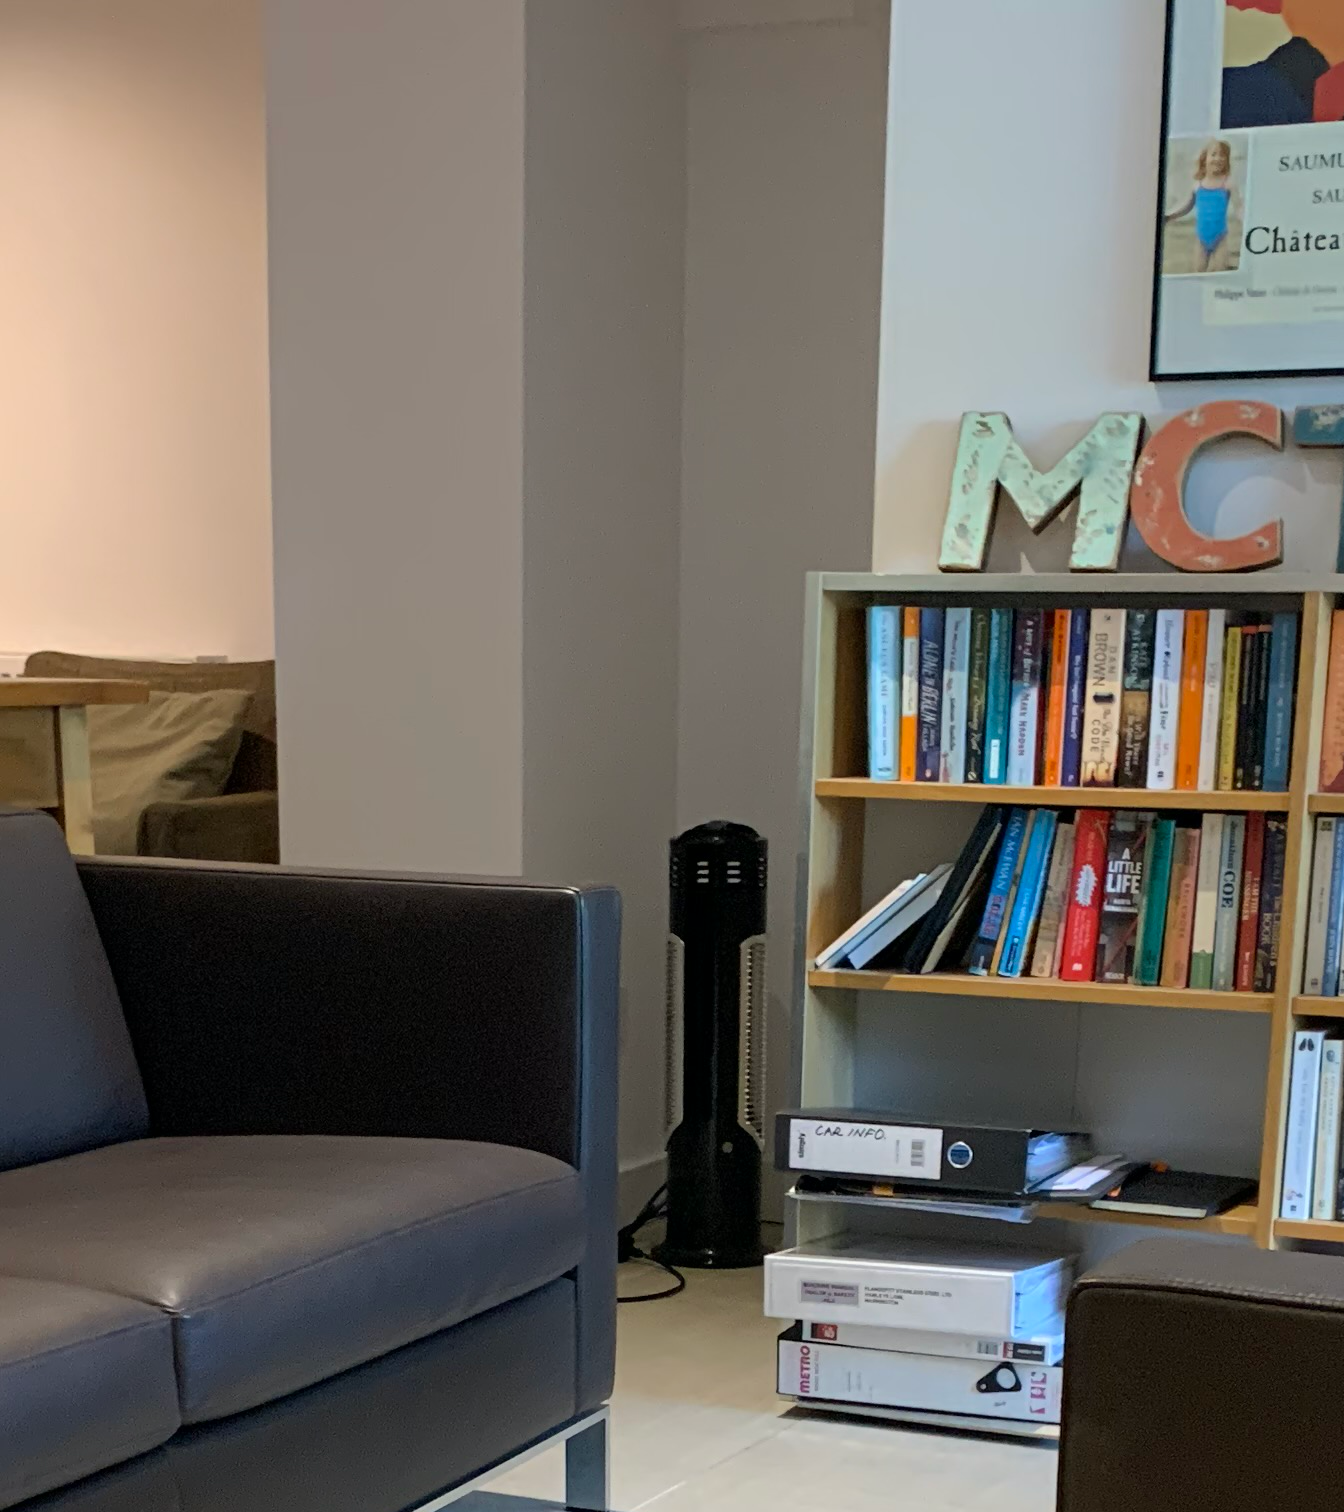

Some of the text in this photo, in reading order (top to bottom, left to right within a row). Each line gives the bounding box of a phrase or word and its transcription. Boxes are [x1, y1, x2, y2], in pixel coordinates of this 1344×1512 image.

[922, 639, 939, 676] ALONE
[1093, 633, 1108, 686] BROWN
[1108, 646, 1117, 674] DAN
[1130, 629, 1139, 683] ATKINSON
[921, 685, 939, 725] BERLIN
[1018, 721, 1027, 756] HADDON
[1090, 719, 1099, 752] CODE
[996, 816, 1022, 891] IAN McEWAN
[1108, 860, 1143, 874] LITTLE
[1121, 847, 1131, 860] A
[1105, 873, 1142, 894] LIFE
[1221, 871, 1236, 908] COE
[1261, 912, 1272, 946] BOOK
[798, 1131, 806, 1159] simply
[815, 1125, 843, 1137] CAR
[799, 1345, 811, 1394] METRO
